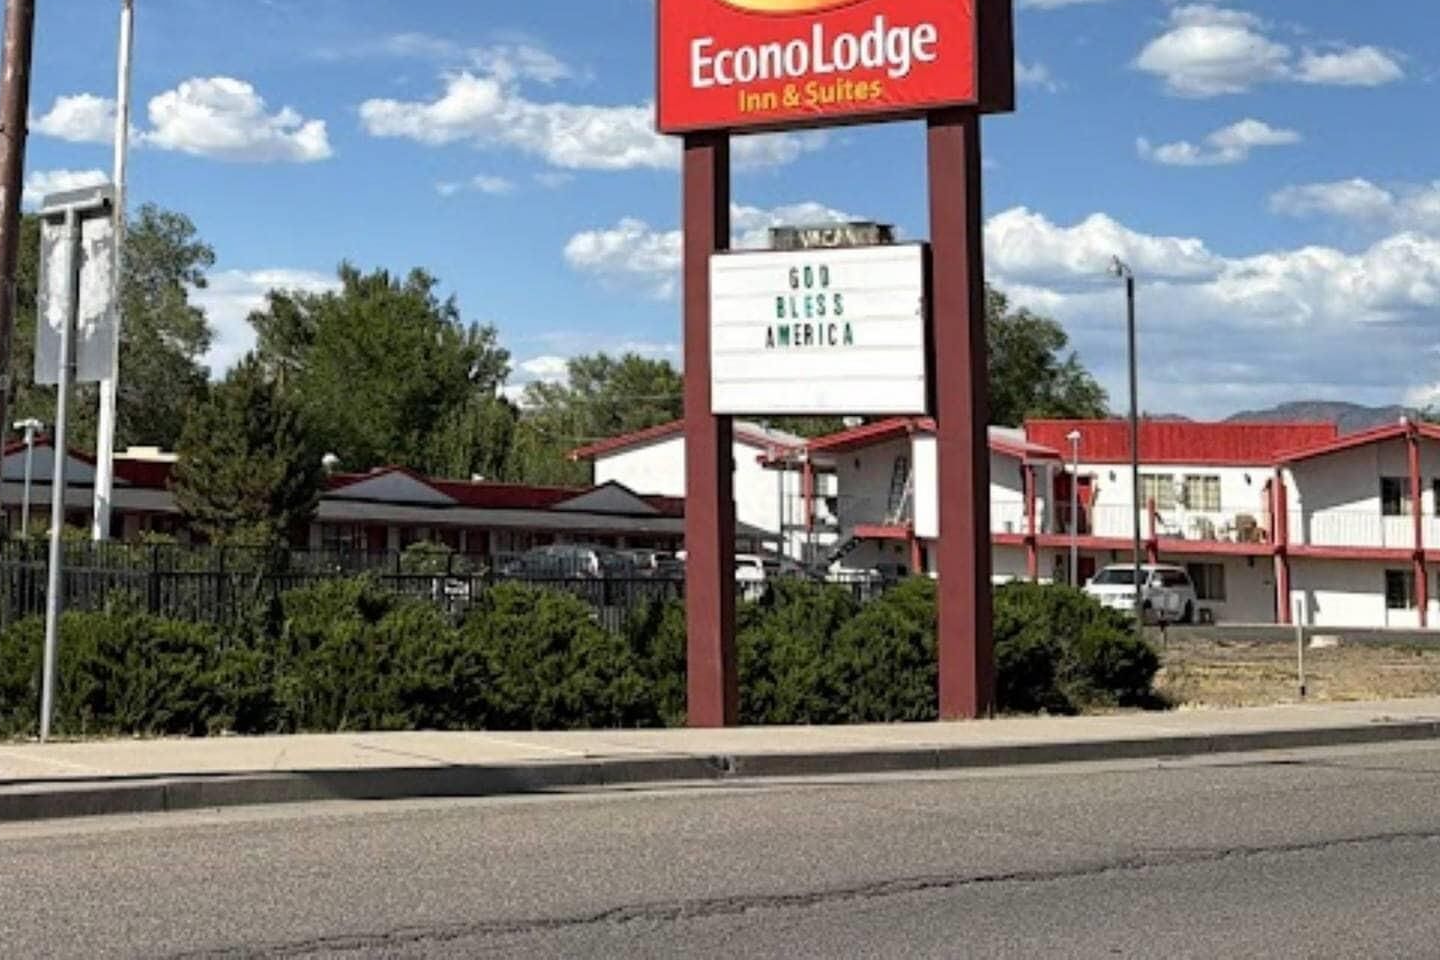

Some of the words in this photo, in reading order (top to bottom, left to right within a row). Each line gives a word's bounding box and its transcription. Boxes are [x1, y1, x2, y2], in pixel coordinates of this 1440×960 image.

[691, 15, 937, 88] EconoLodge
[738, 89, 778, 112] Inn
[782, 84, 801, 107] &
[804, 78, 883, 106] Suites
[789, 265, 829, 289] GOD
[776, 293, 844, 319] BLESS
[765, 322, 853, 348] AMERICA
